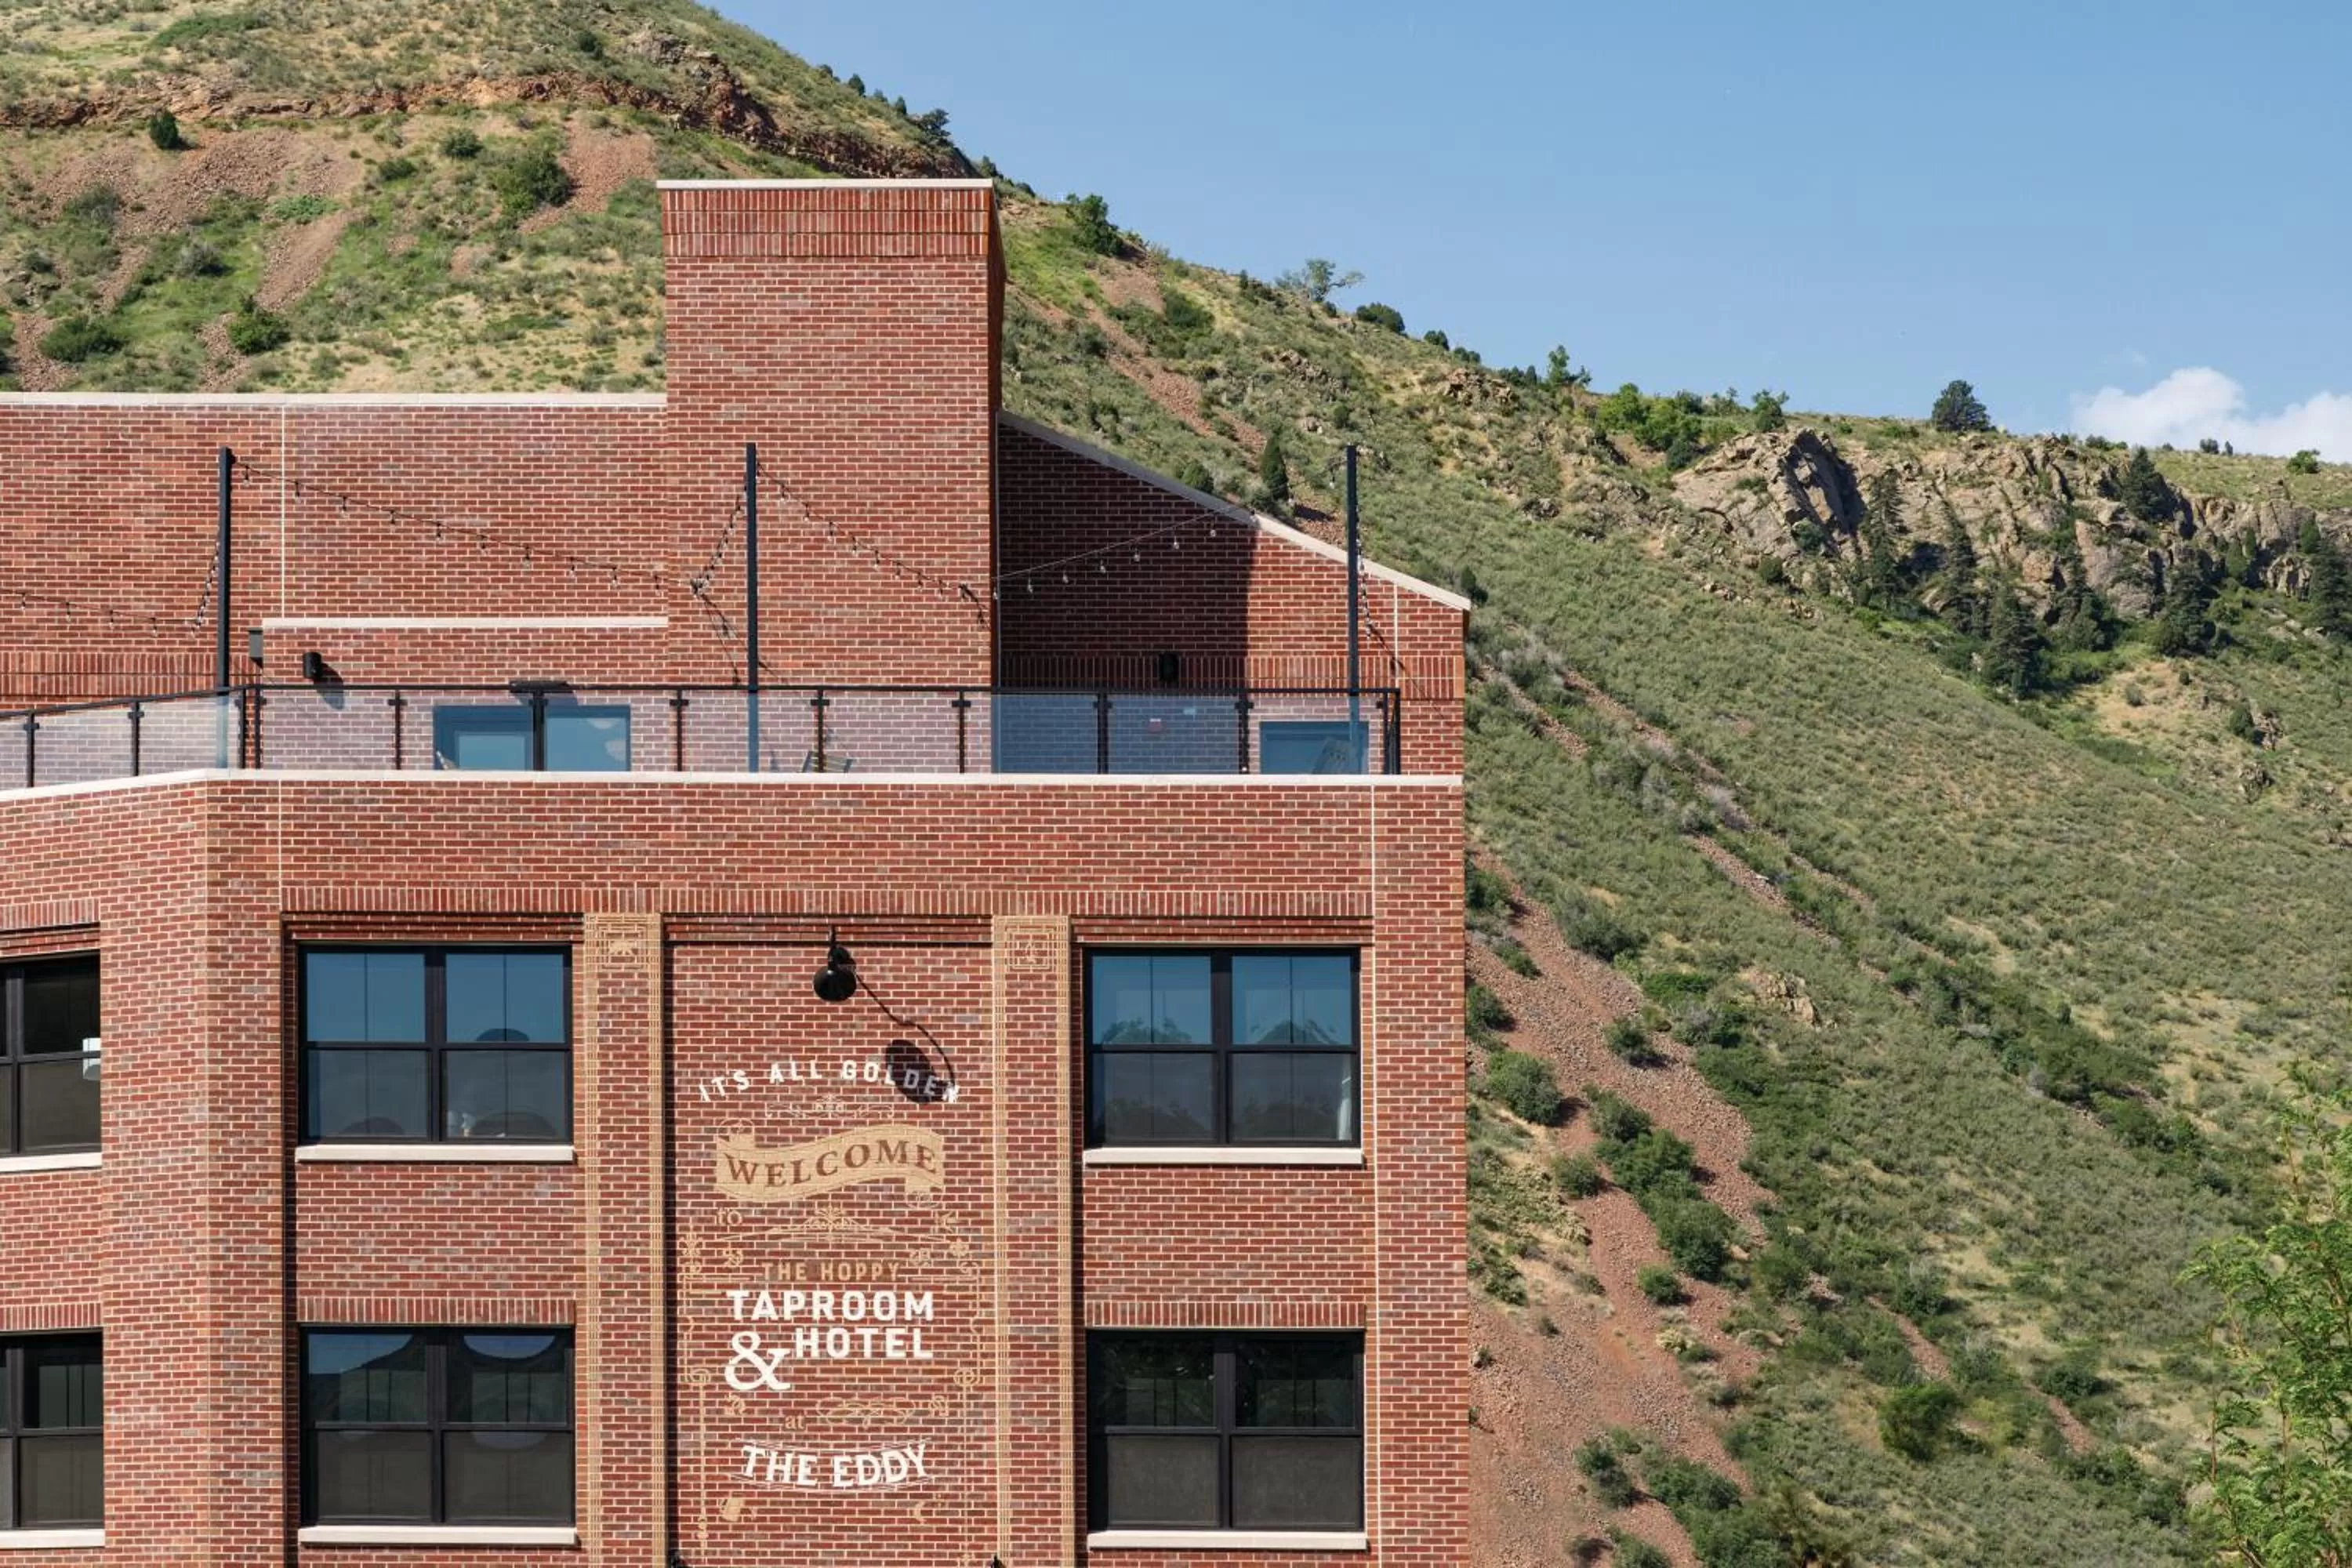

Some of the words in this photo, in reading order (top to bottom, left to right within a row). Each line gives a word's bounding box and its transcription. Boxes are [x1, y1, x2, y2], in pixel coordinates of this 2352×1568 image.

[769, 1060, 823, 1083] ALL
[840, 1060, 960, 1103] GOLDEN
[724, 1139, 938, 1188] WELCOME
[717, 1207, 742, 1226] to
[761, 1261, 808, 1281] THE
[821, 1261, 901, 1281] HOPPY
[726, 1290, 934, 1321] TAPROOM
[724, 1331, 792, 1390] &
[795, 1328, 935, 1359] HOTEL
[785, 1413, 805, 1430] at
[741, 1444, 818, 1486] THE
[833, 1443, 927, 1487] EDDY
